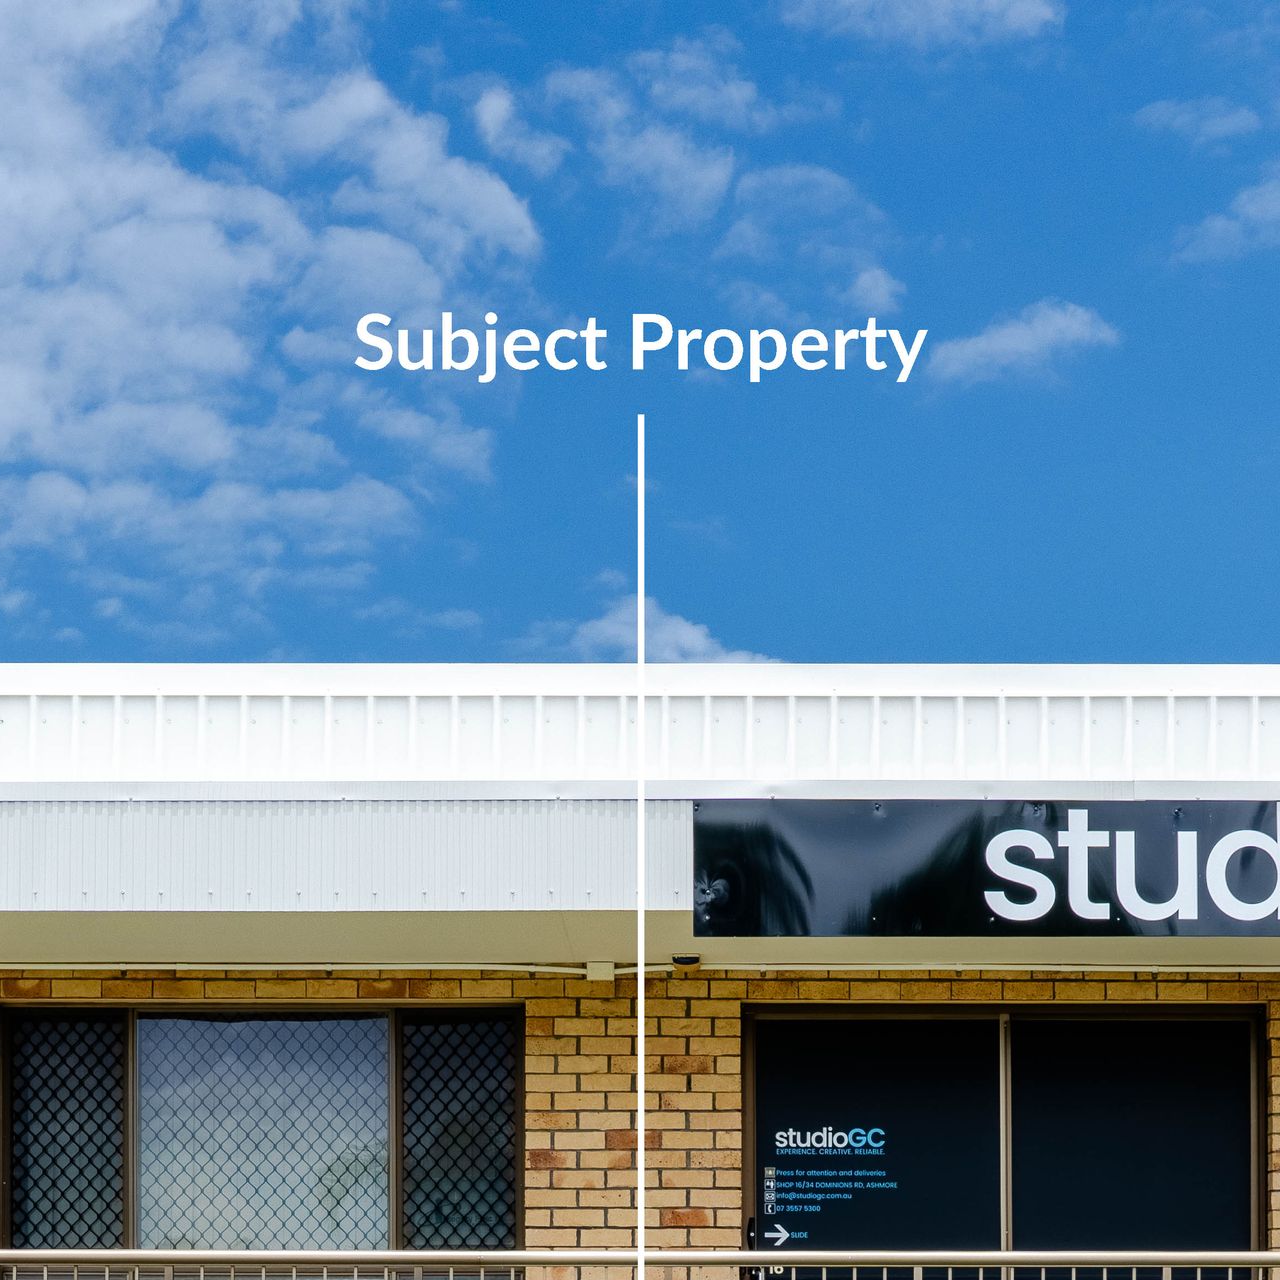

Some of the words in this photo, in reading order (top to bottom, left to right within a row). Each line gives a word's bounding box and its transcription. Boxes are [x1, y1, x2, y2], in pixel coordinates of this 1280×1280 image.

[775, 1127, 885, 1147] studioGC
[795, 1181, 814, 1189] 16/34
[776, 1192, 852, 1200] info@studiogc.com.au
